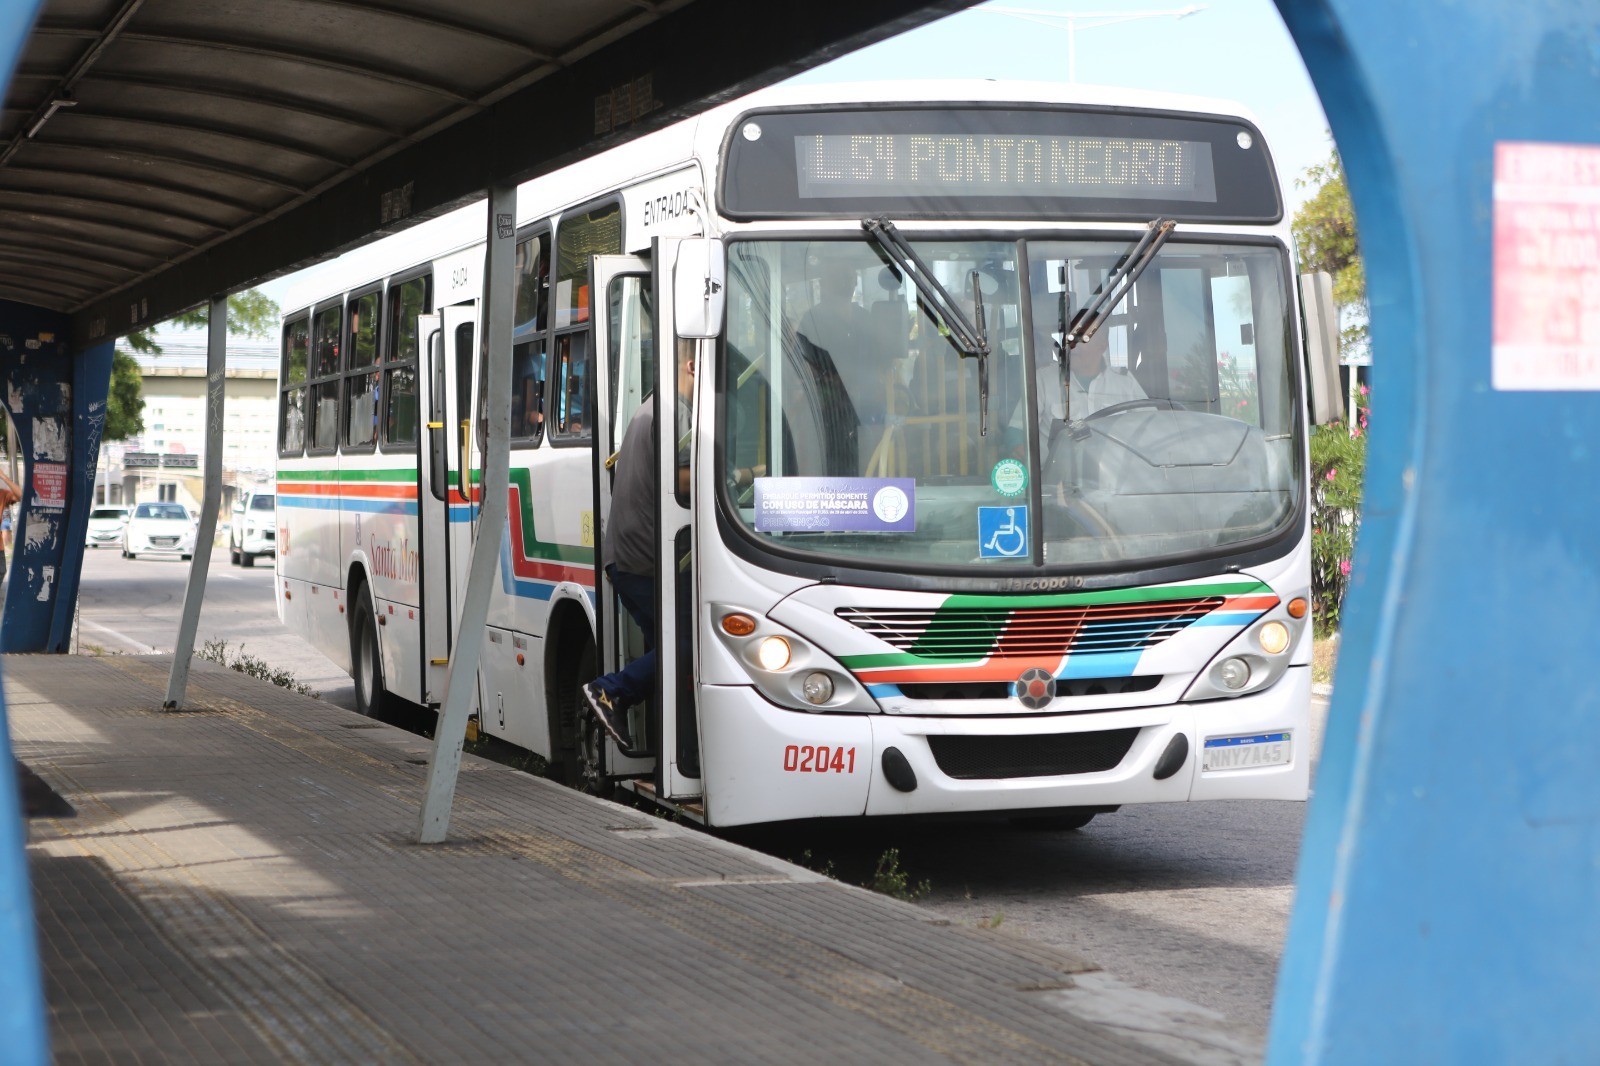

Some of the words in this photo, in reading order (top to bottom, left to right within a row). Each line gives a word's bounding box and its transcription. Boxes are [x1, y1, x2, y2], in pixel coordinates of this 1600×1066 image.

[816, 135, 841, 179] L
[852, 136, 896, 180] 54
[911, 137, 1041, 183] PONTA
[1052, 140, 1182, 187] NEGRA
[644, 190, 688, 227] ENTRADA
[762, 500, 784, 509] COM
[785, 500, 805, 509] USO
[806, 500, 819, 509] DE
[820, 499, 869, 509] MÁSCARA
[762, 516, 830, 529] PREVENÇÃO
[370, 533, 397, 580] Santa
[783, 745, 856, 774] 02041
[1210, 745, 1281, 768] NNY7A45
